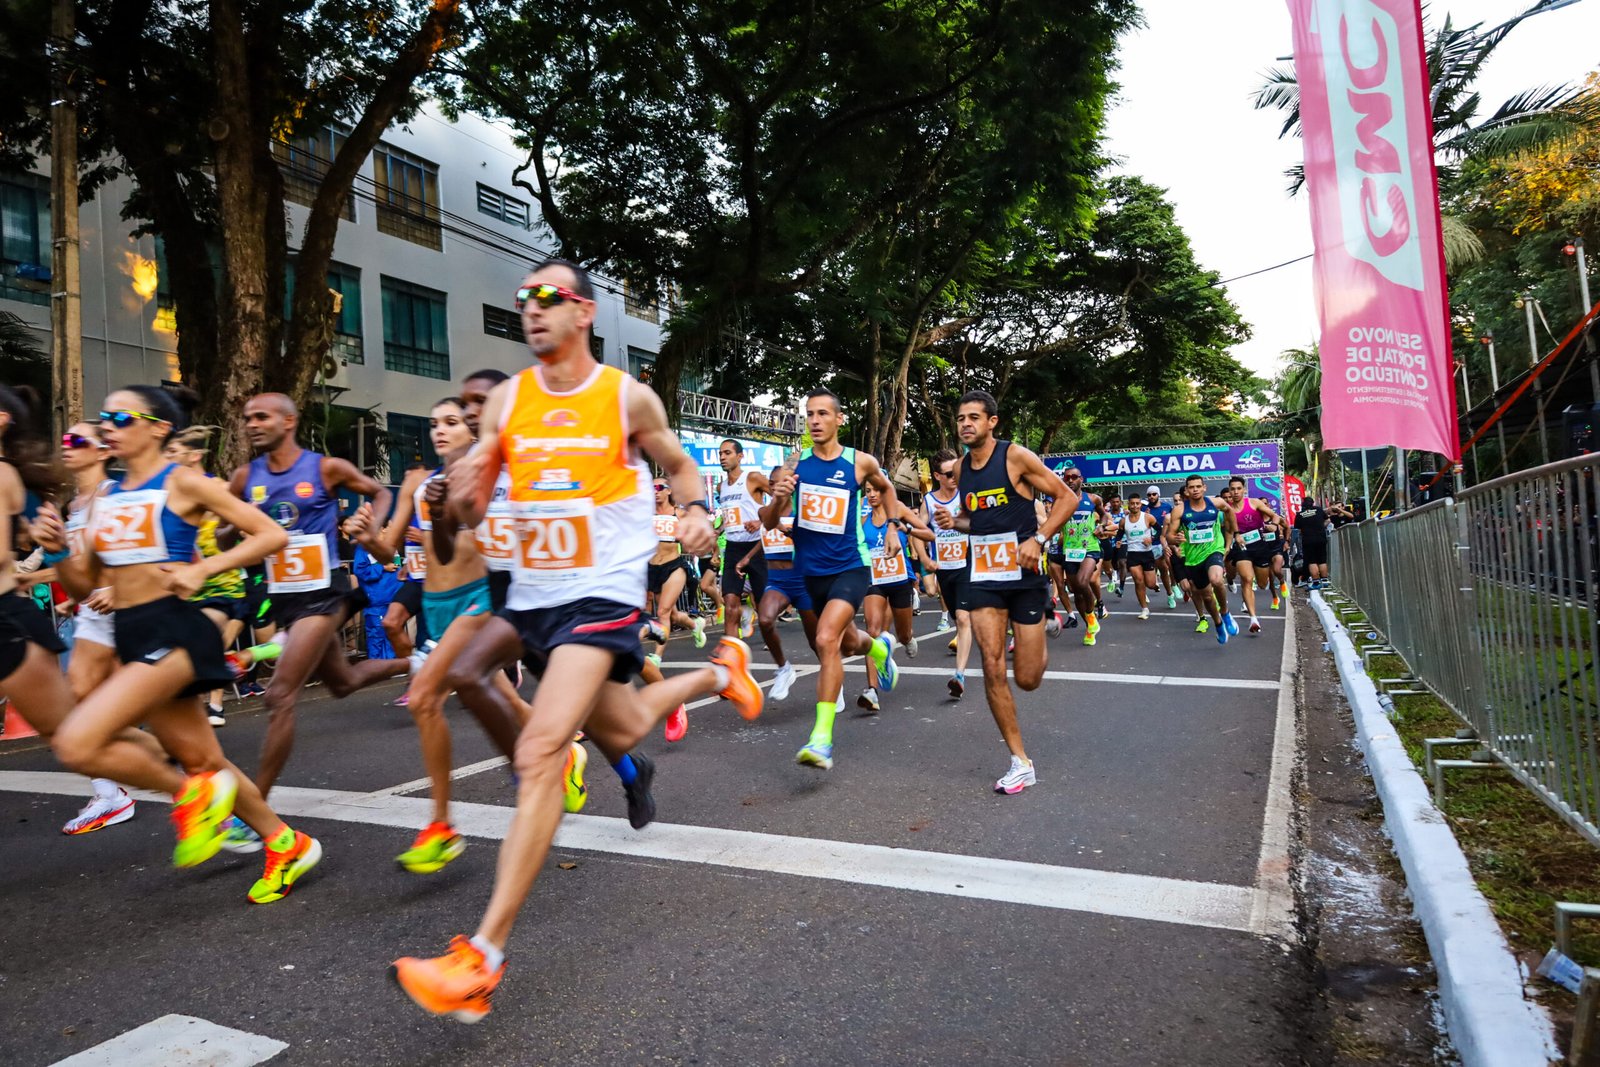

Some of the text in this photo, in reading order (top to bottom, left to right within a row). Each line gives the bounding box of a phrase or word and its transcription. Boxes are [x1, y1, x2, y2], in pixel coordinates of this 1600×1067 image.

[1103, 454, 1216, 475] LARGADA
[807, 495, 837, 519] 30
[1287, 483, 1302, 513] CBN
[100, 506, 146, 543] 52
[475, 519, 516, 551] 45
[656, 521, 675, 533] 56
[525, 519, 577, 559] 20
[943, 544, 963, 558] 28
[285, 549, 305, 575] 5
[877, 557, 898, 573] 49
[982, 543, 1010, 567] 14
